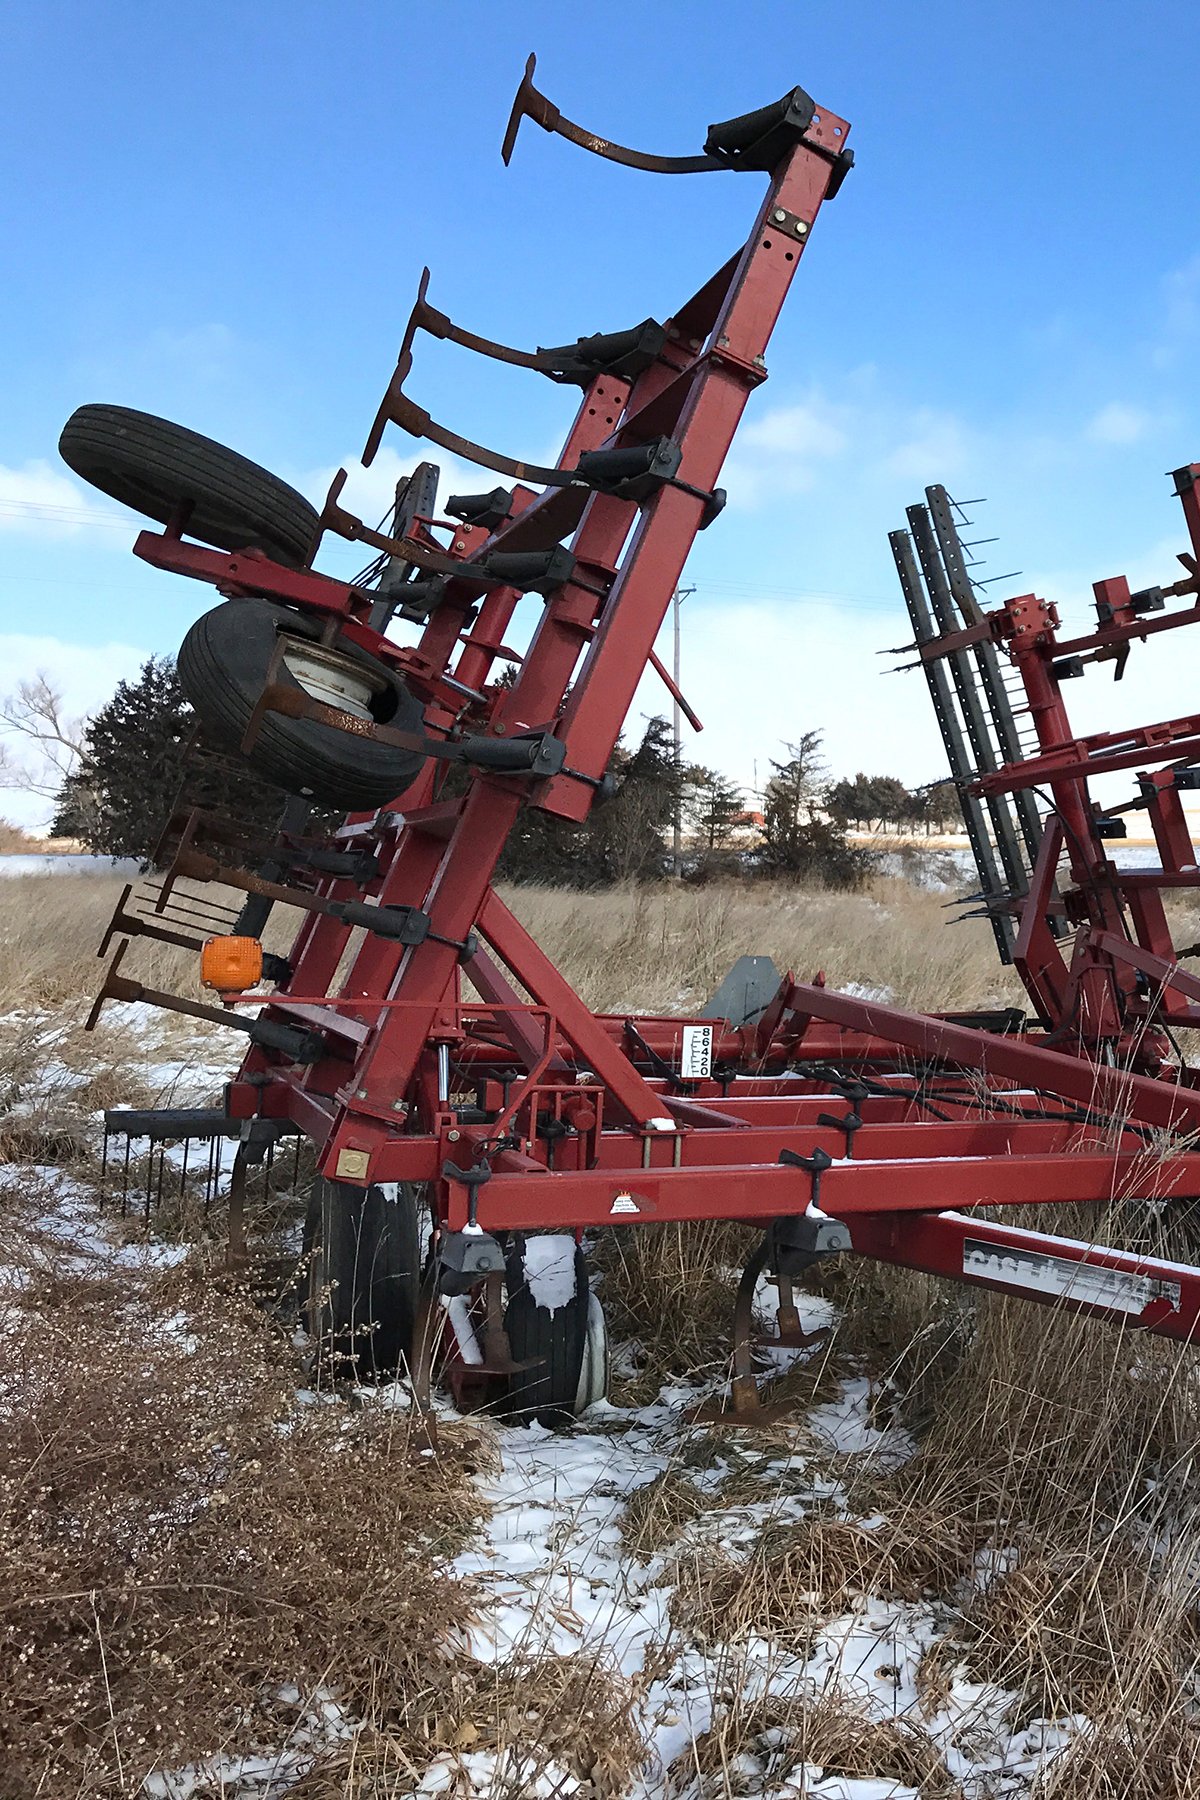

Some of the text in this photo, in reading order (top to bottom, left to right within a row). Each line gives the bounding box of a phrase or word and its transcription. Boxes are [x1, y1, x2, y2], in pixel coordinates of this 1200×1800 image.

[702, 1028, 710, 1036] 8
[702, 1038, 710, 1046] 6
[701, 1048, 709, 1056] 4
[700, 1057, 708, 1066] 2
[700, 1067, 708, 1076] 0
